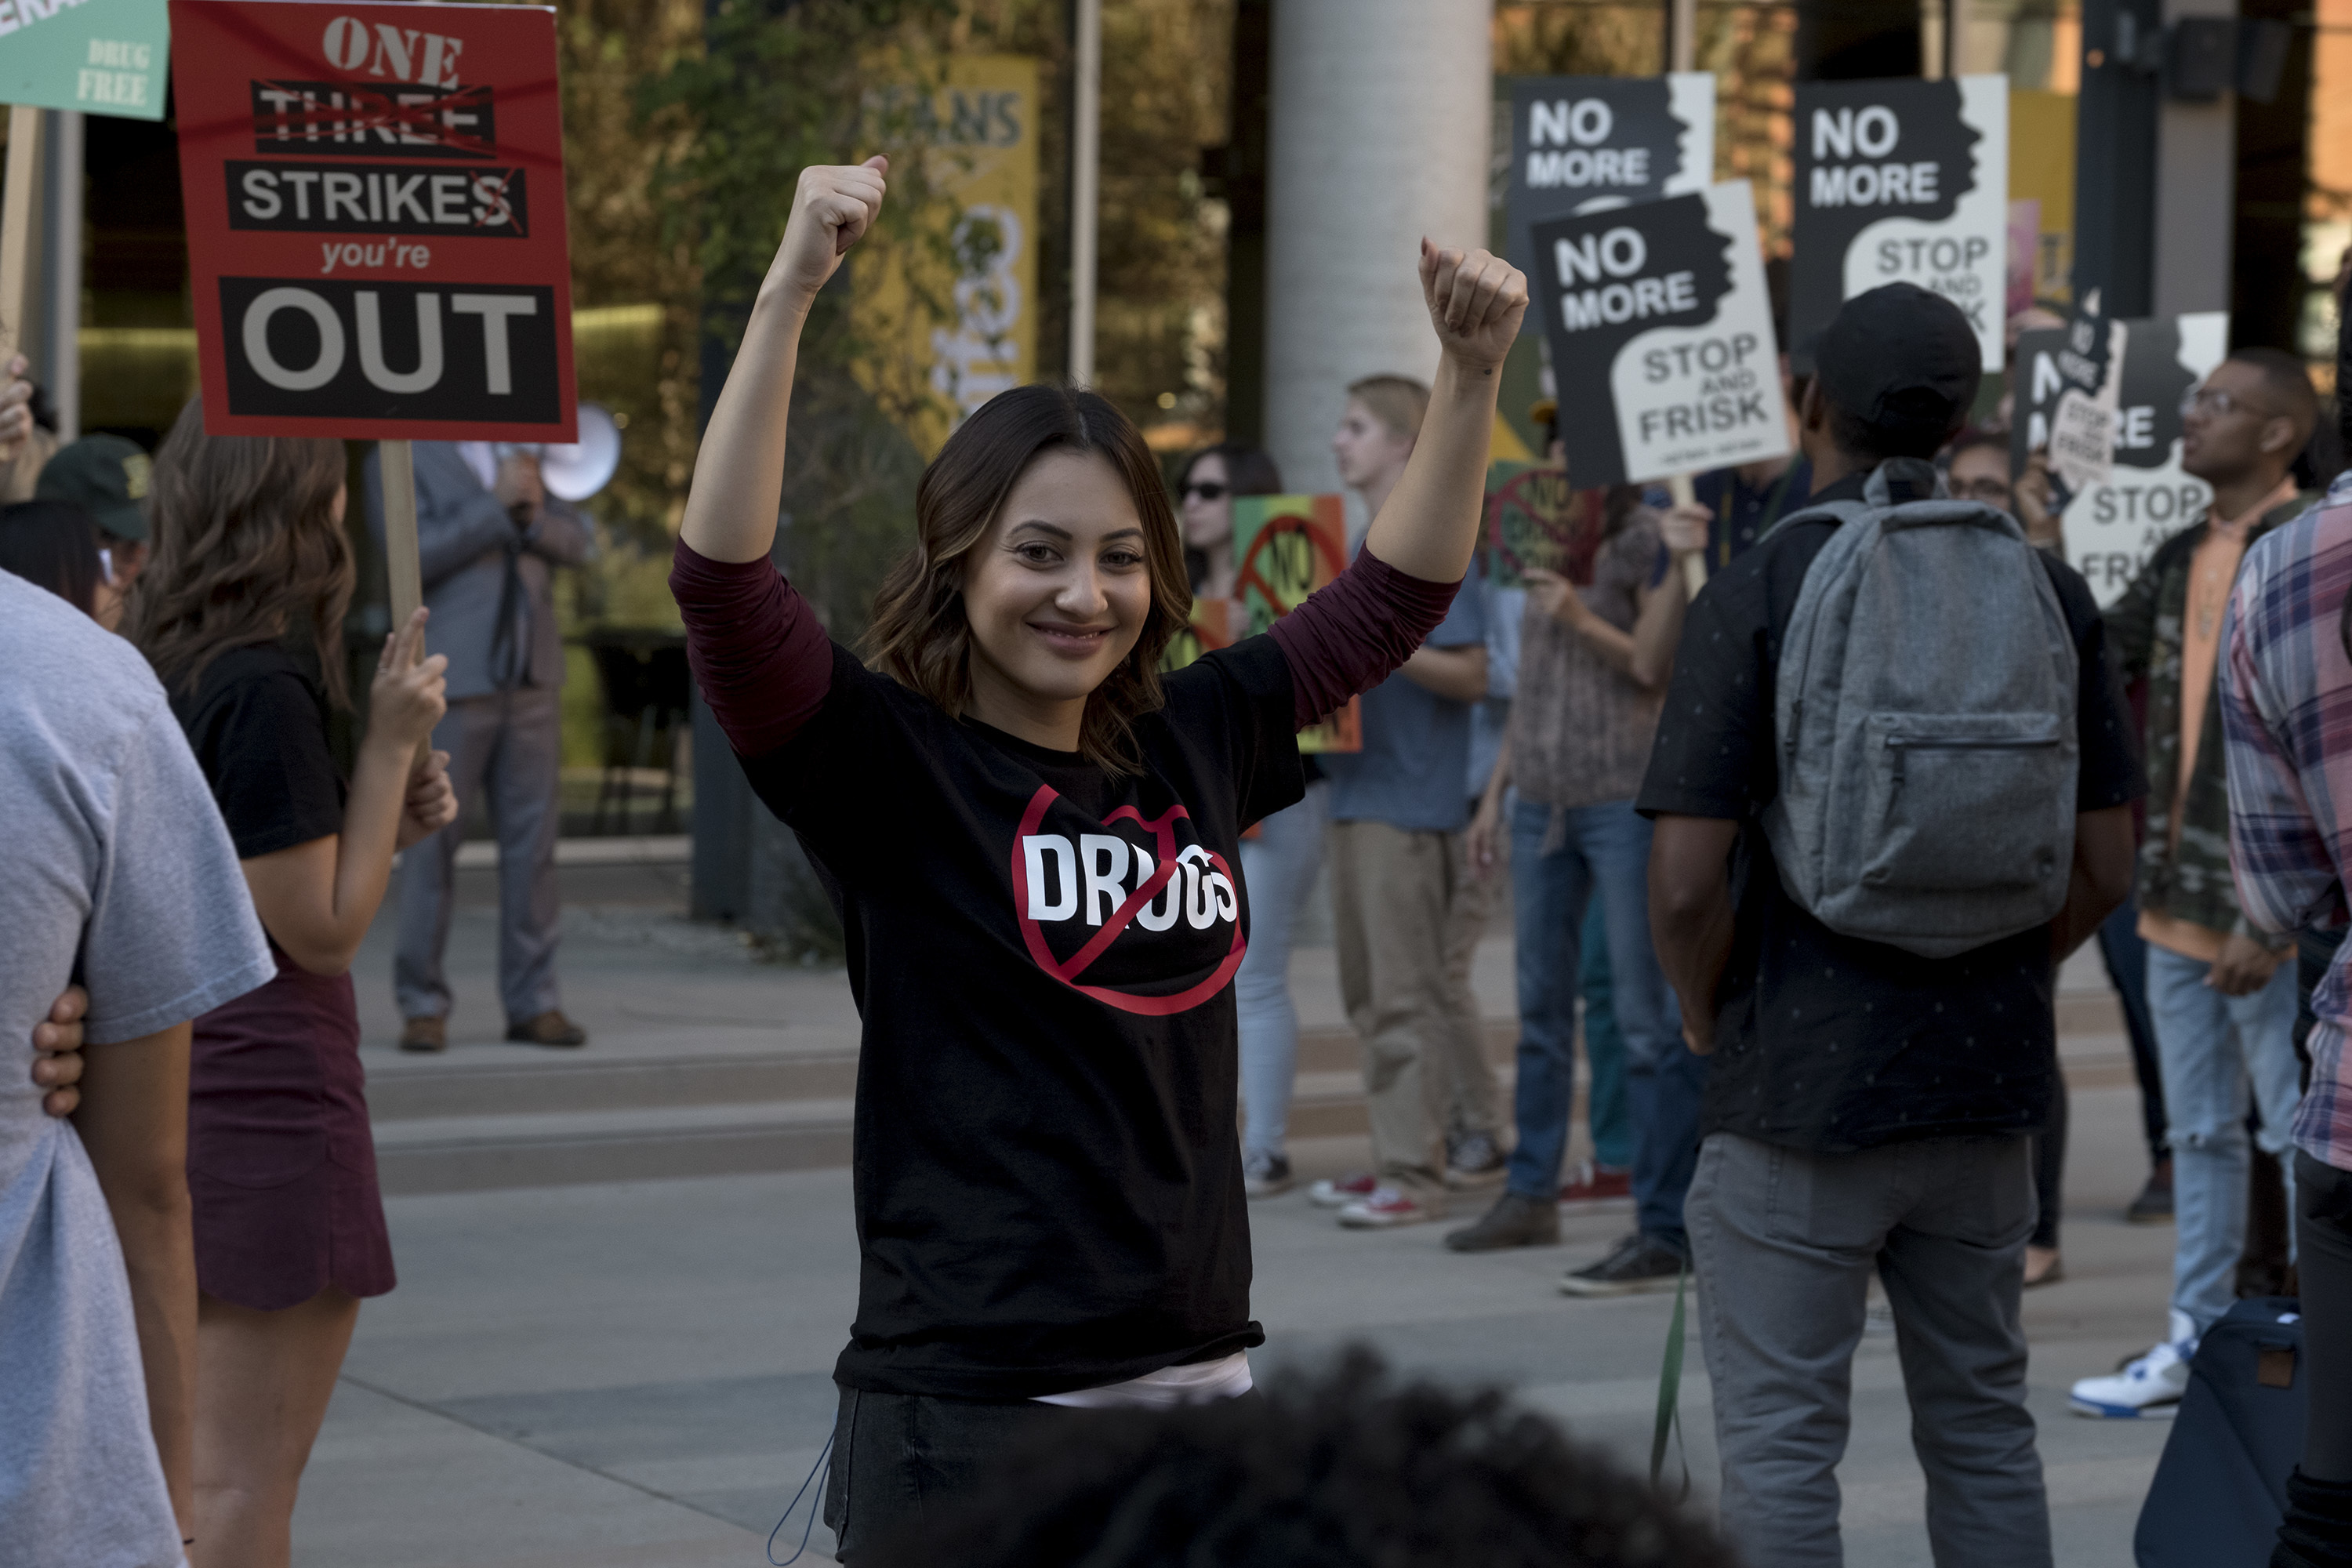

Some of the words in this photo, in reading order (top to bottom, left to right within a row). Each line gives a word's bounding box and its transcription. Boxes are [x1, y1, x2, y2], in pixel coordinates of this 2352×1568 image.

[88, 38, 151, 69] DRUG
[322, 16, 463, 90] ONE
[77, 68, 148, 106] FREE
[260, 90, 481, 145] THREE
[1529, 99, 1613, 147] NO
[1811, 105, 1900, 158] NO
[1526, 149, 1649, 188] MORE
[1809, 162, 1940, 207] MORE
[242, 169, 511, 226] STRIKES
[321, 238, 430, 273] you're
[1554, 227, 1646, 287] NO
[1877, 235, 1990, 275] STOP
[1561, 271, 1697, 332] MORE
[242, 287, 537, 394] OUT
[1643, 332, 1759, 385] STOP
[1700, 368, 1758, 396] AND
[1639, 391, 1769, 445] FRISK
[2092, 485, 2203, 525] STOP
